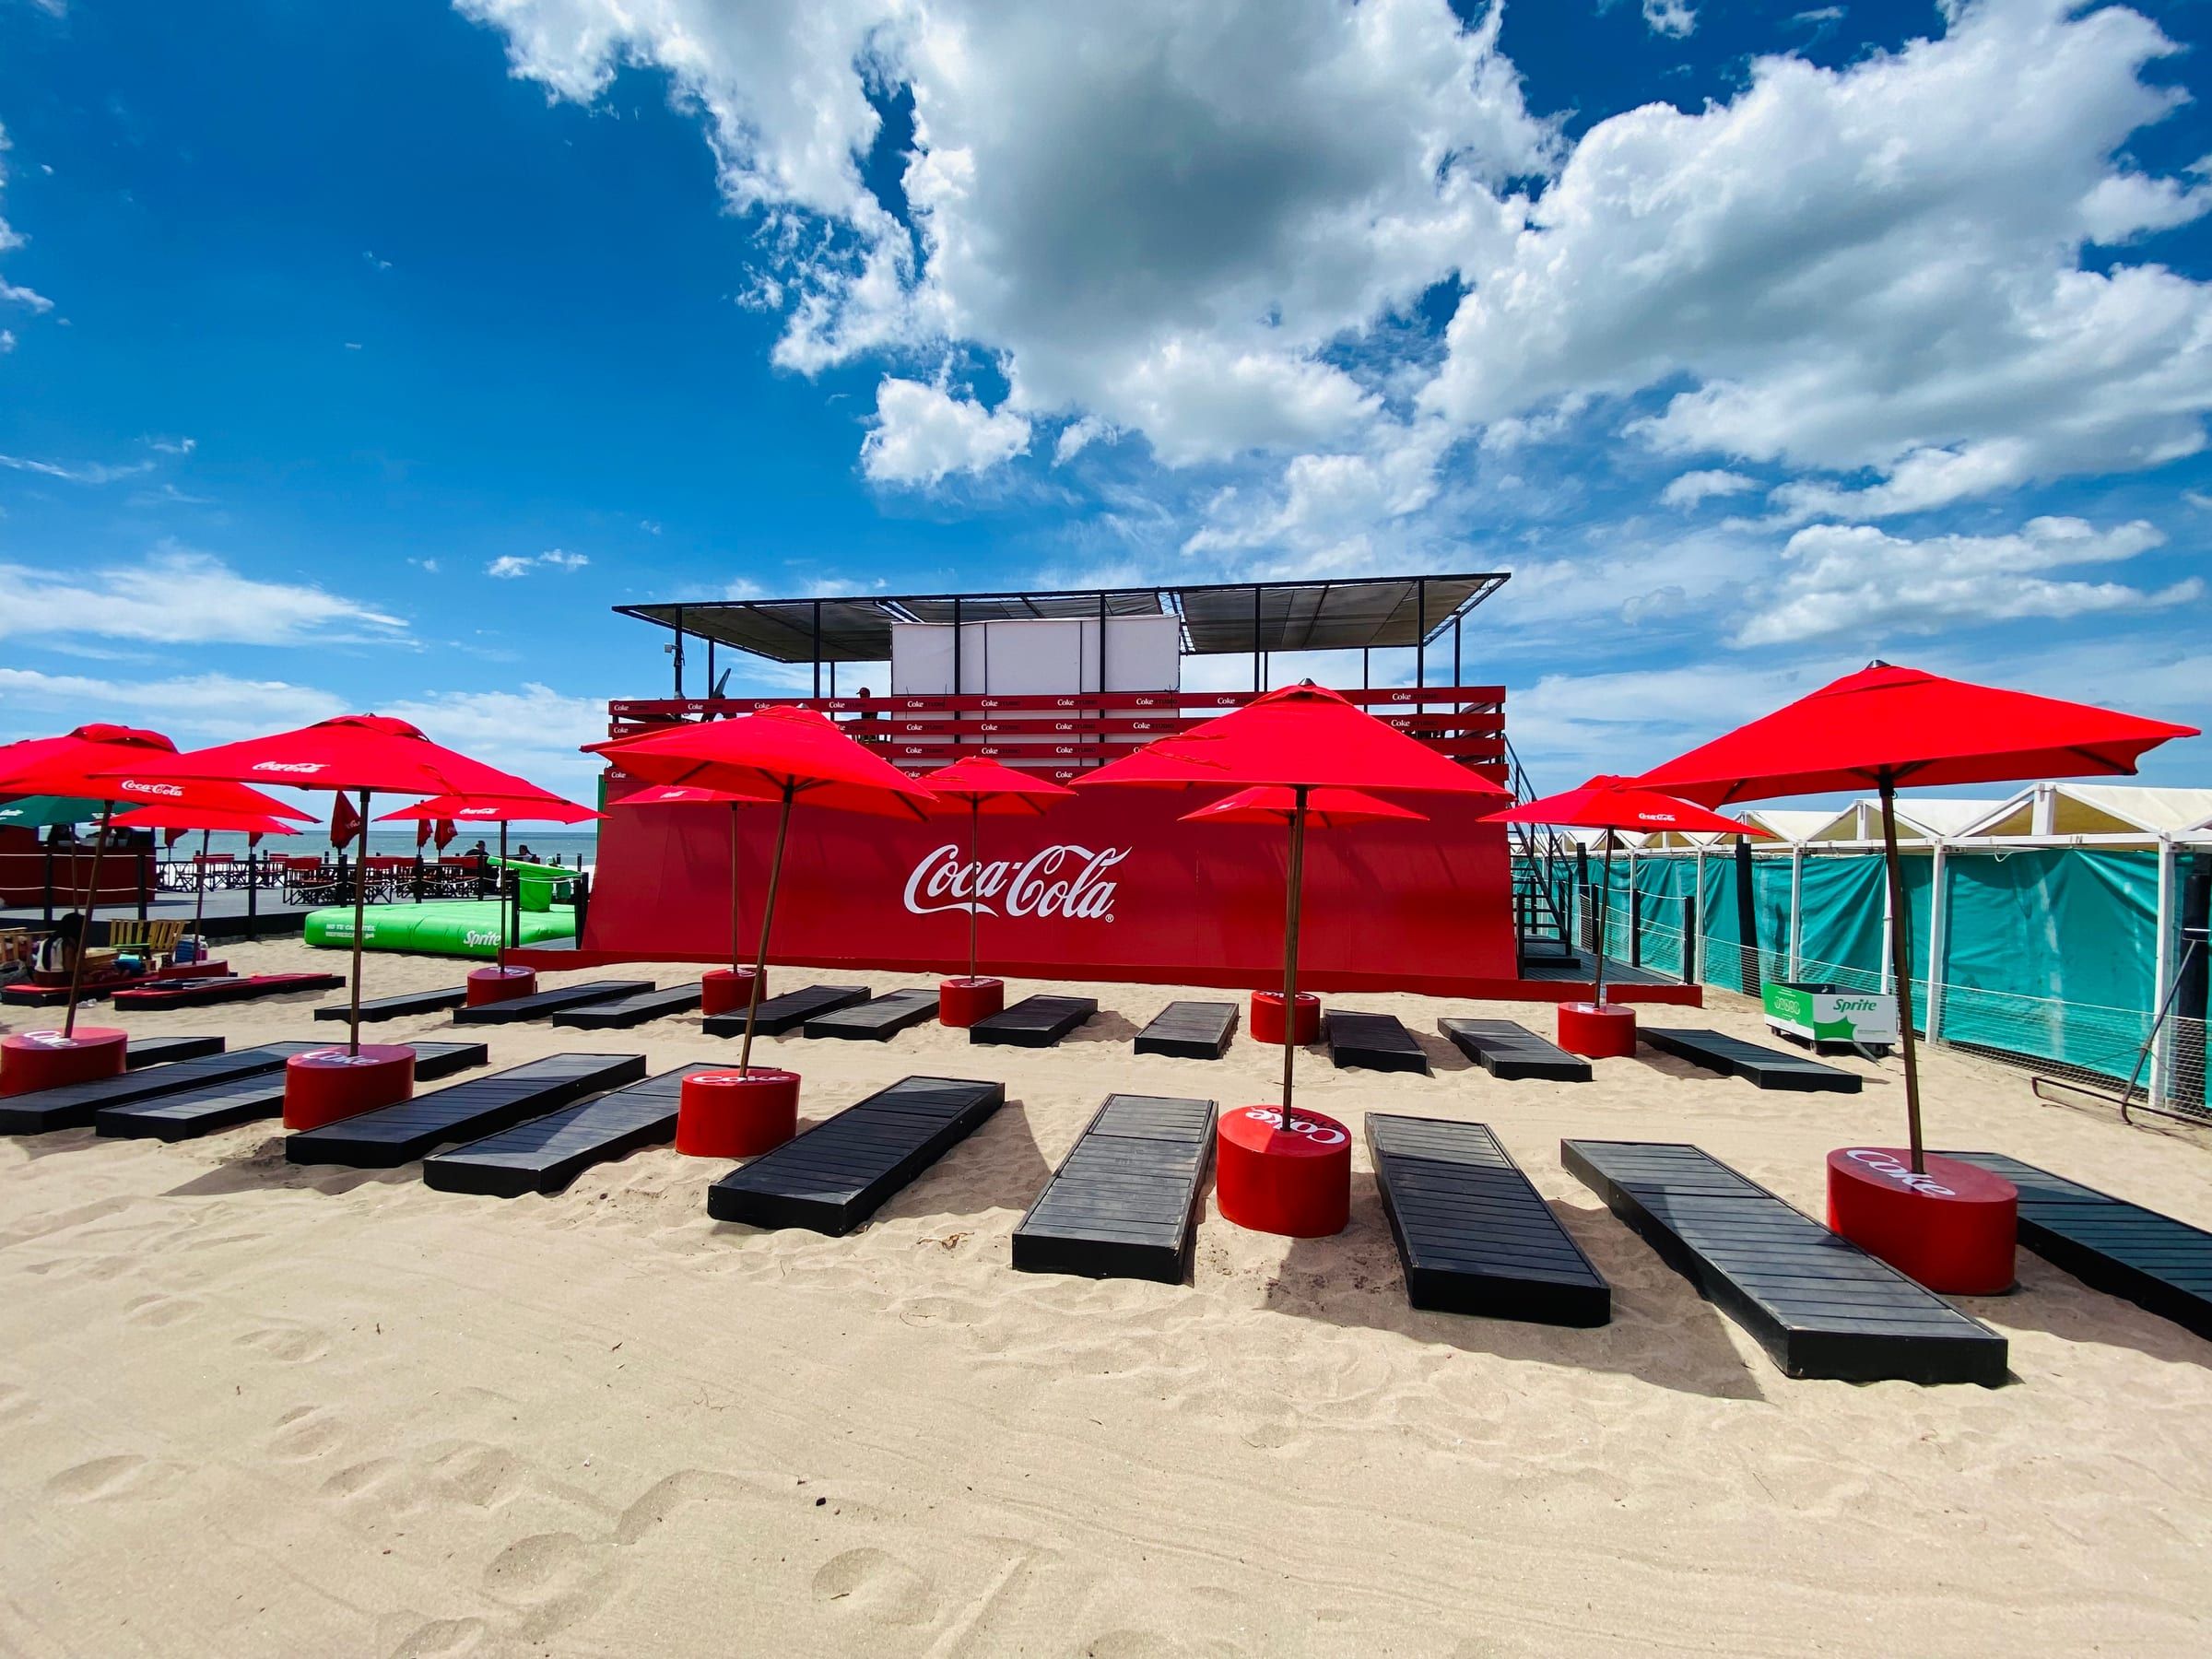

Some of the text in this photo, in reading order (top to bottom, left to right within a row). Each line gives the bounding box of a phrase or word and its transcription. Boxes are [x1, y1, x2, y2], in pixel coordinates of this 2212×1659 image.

[688, 702, 703, 711] Coke
[122, 780, 184, 796] Coca-Cola
[904, 844, 1133, 919] Coca-Cola
[463, 930, 501, 947] Sprite
[1833, 998, 1877, 1012] Sprite
[1846, 1150, 1956, 1196] Coke
